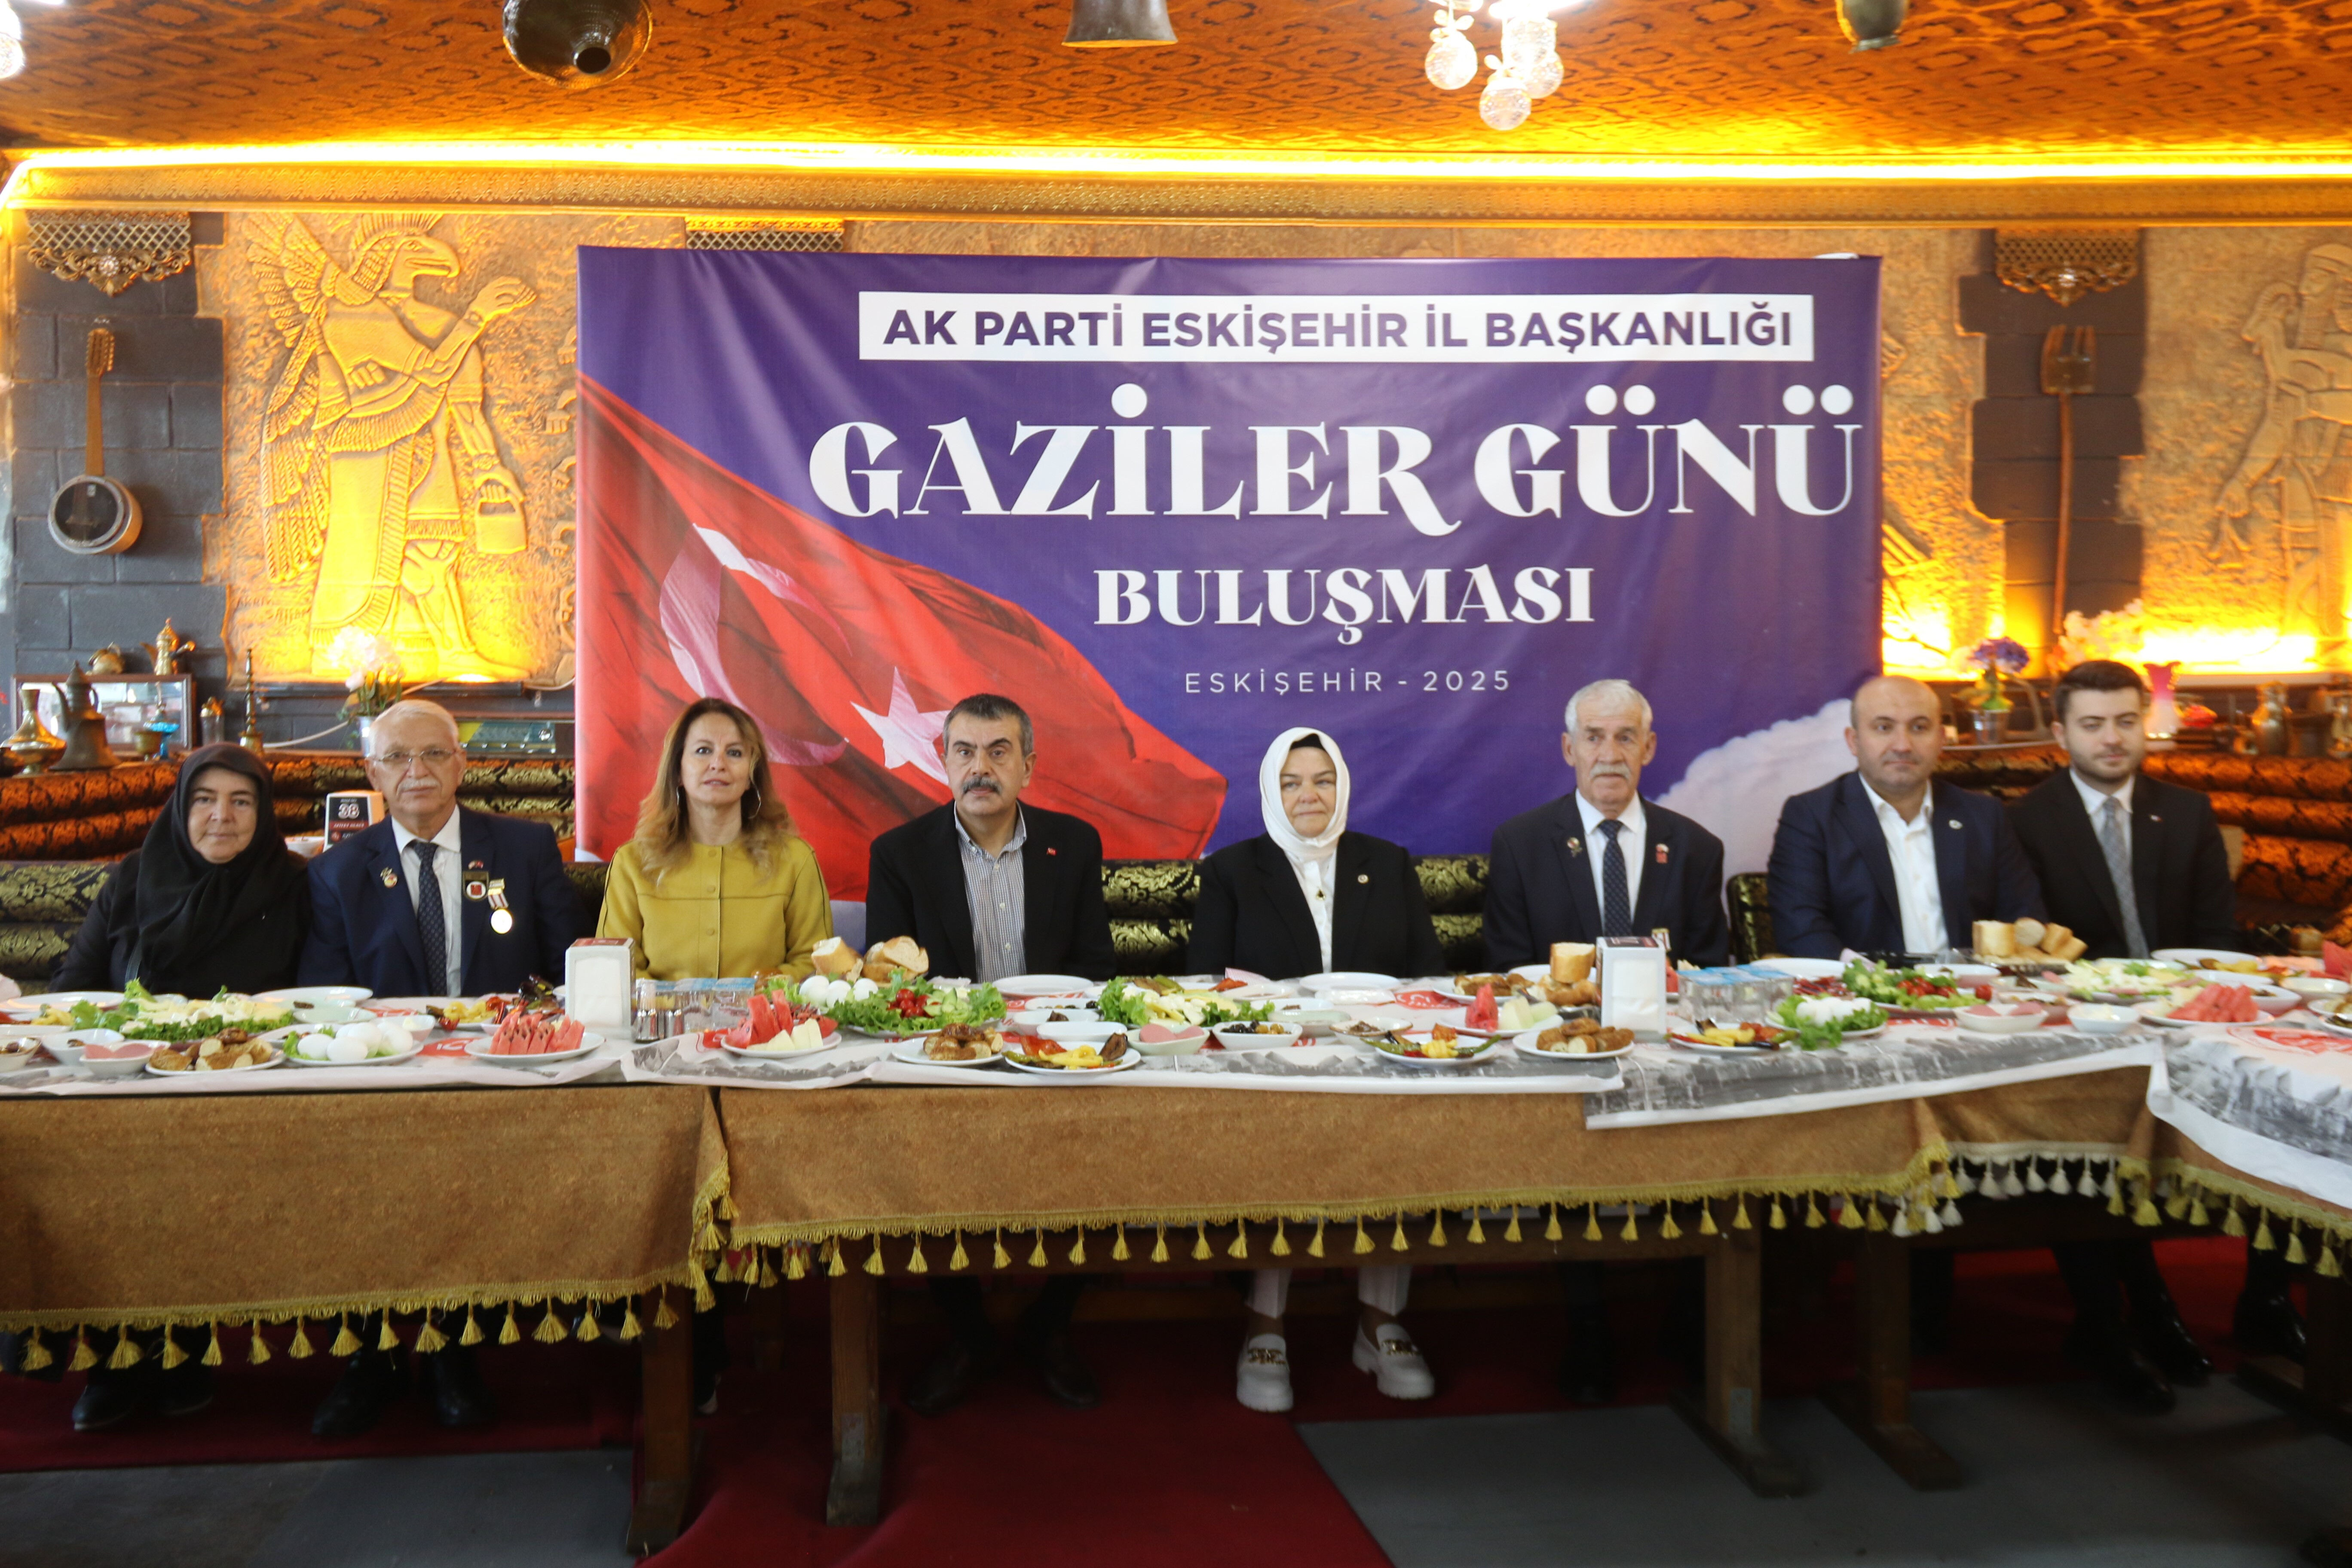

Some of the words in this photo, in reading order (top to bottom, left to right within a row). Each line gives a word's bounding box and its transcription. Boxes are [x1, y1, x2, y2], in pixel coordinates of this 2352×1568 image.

[883, 309, 957, 346] AK
[975, 302, 1123, 346] PARTİ
[1143, 303, 1408, 353] ESKİŞEHİR
[1428, 303, 1467, 346] İL
[1487, 301, 1791, 353] BAŞKANLIĞI
[809, 383, 1462, 536] GAZİLER
[1473, 384, 1863, 519] GÜNÜ
[1093, 564, 1595, 646] BULUŞMASI
[1185, 667, 1382, 696] ESKİŞEHİR
[1422, 669, 1509, 692] 2025
